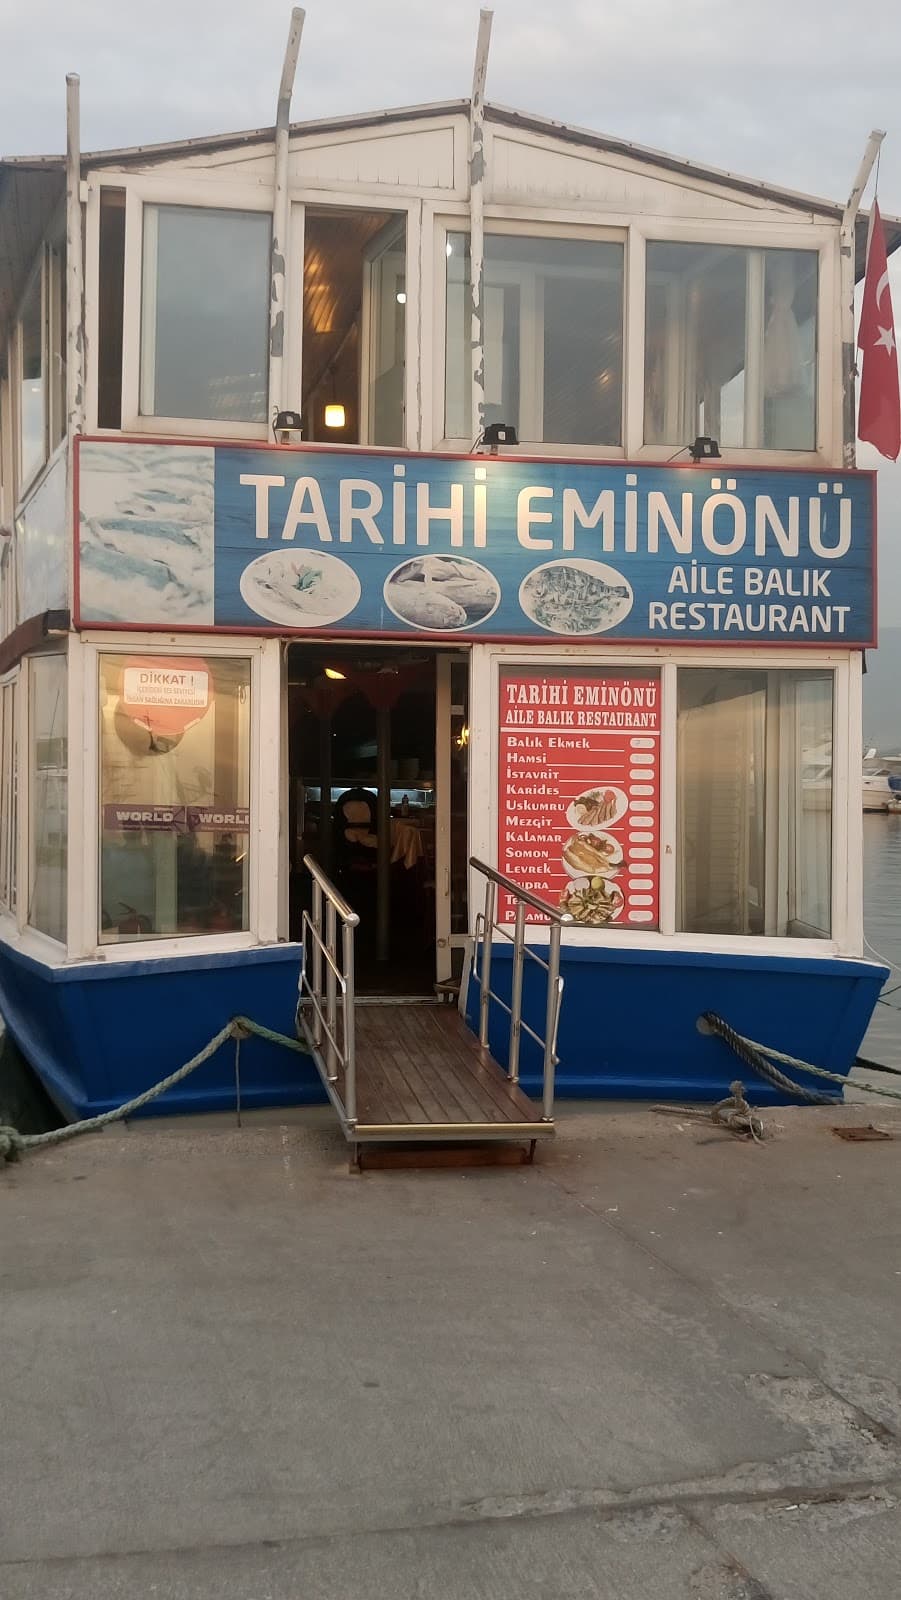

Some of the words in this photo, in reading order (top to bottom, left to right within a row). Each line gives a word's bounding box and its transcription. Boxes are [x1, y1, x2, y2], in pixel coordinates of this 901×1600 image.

[240, 464, 487, 548] TARİHİ
[516, 473, 852, 559] EMİNÖNÜ
[668, 559, 734, 595] AİLE
[745, 567, 832, 598] BALIK
[649, 601, 850, 633] RESTAURANT
[140, 671, 186, 685] DİKKAT
[506, 679, 568, 705] TARİHİ
[573, 680, 657, 708] EMİNÖNÜ
[505, 705, 534, 725] AİLE
[537, 709, 575, 726] BALIK
[577, 711, 657, 727] RESTAURANT
[548, 736, 590, 749] Ekmek
[506, 752, 547, 764] Hamsi
[506, 765, 559, 780] İstavrit
[506, 783, 559, 795] Karides
[505, 799, 565, 811] Uskumru
[116, 811, 174, 822] WORLD
[505, 831, 562, 843] Kalamar
[504, 847, 549, 858] Somon
[504, 862, 551, 874] Levrek
